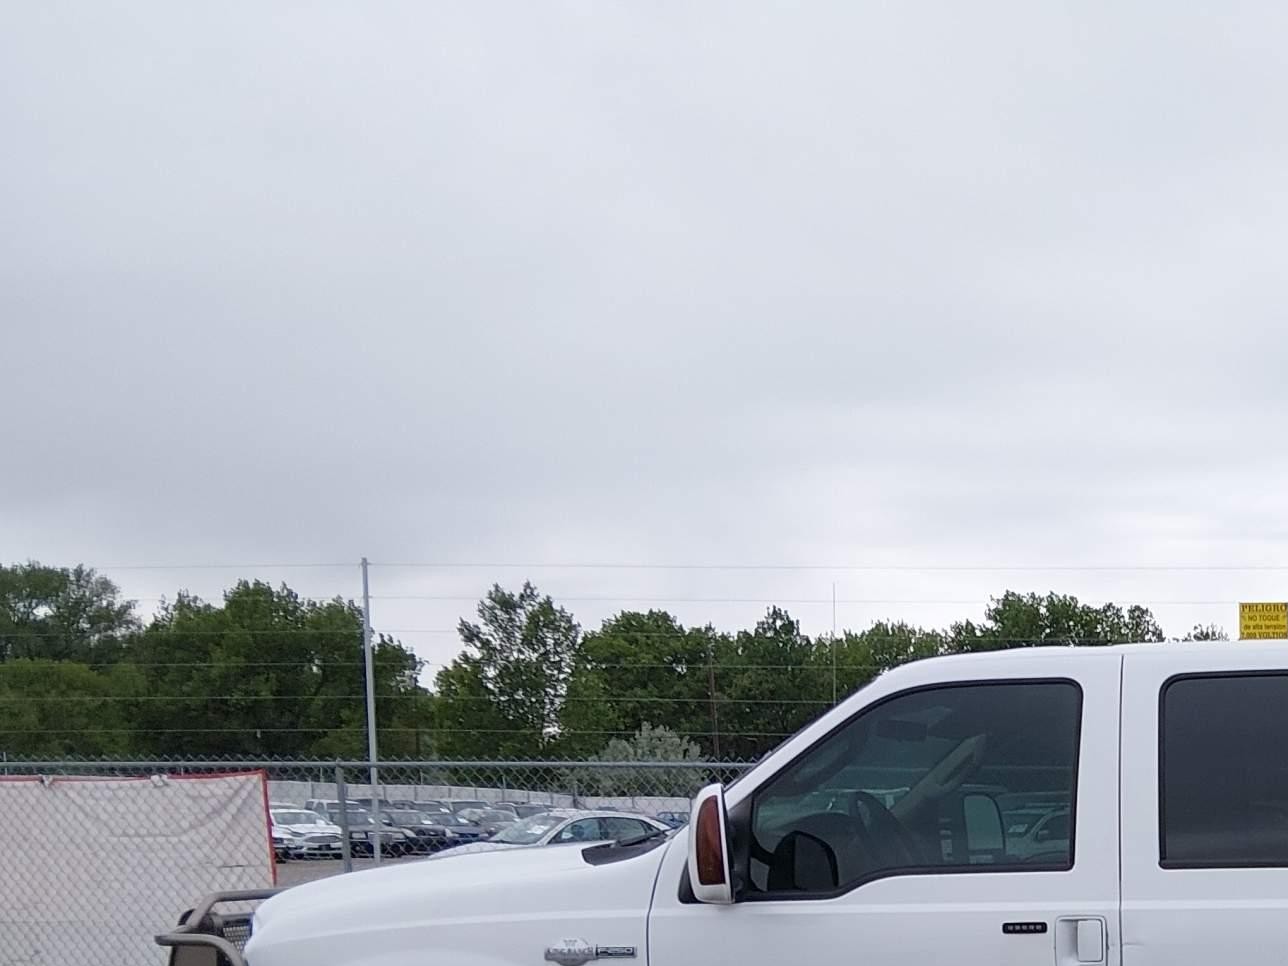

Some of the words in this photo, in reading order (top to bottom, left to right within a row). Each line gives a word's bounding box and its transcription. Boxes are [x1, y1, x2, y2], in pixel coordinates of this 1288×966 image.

[1241, 604, 1287, 612] PELIGRO
[1247, 614, 1257, 622] NO
[1259, 614, 1280, 622] TOQUE
